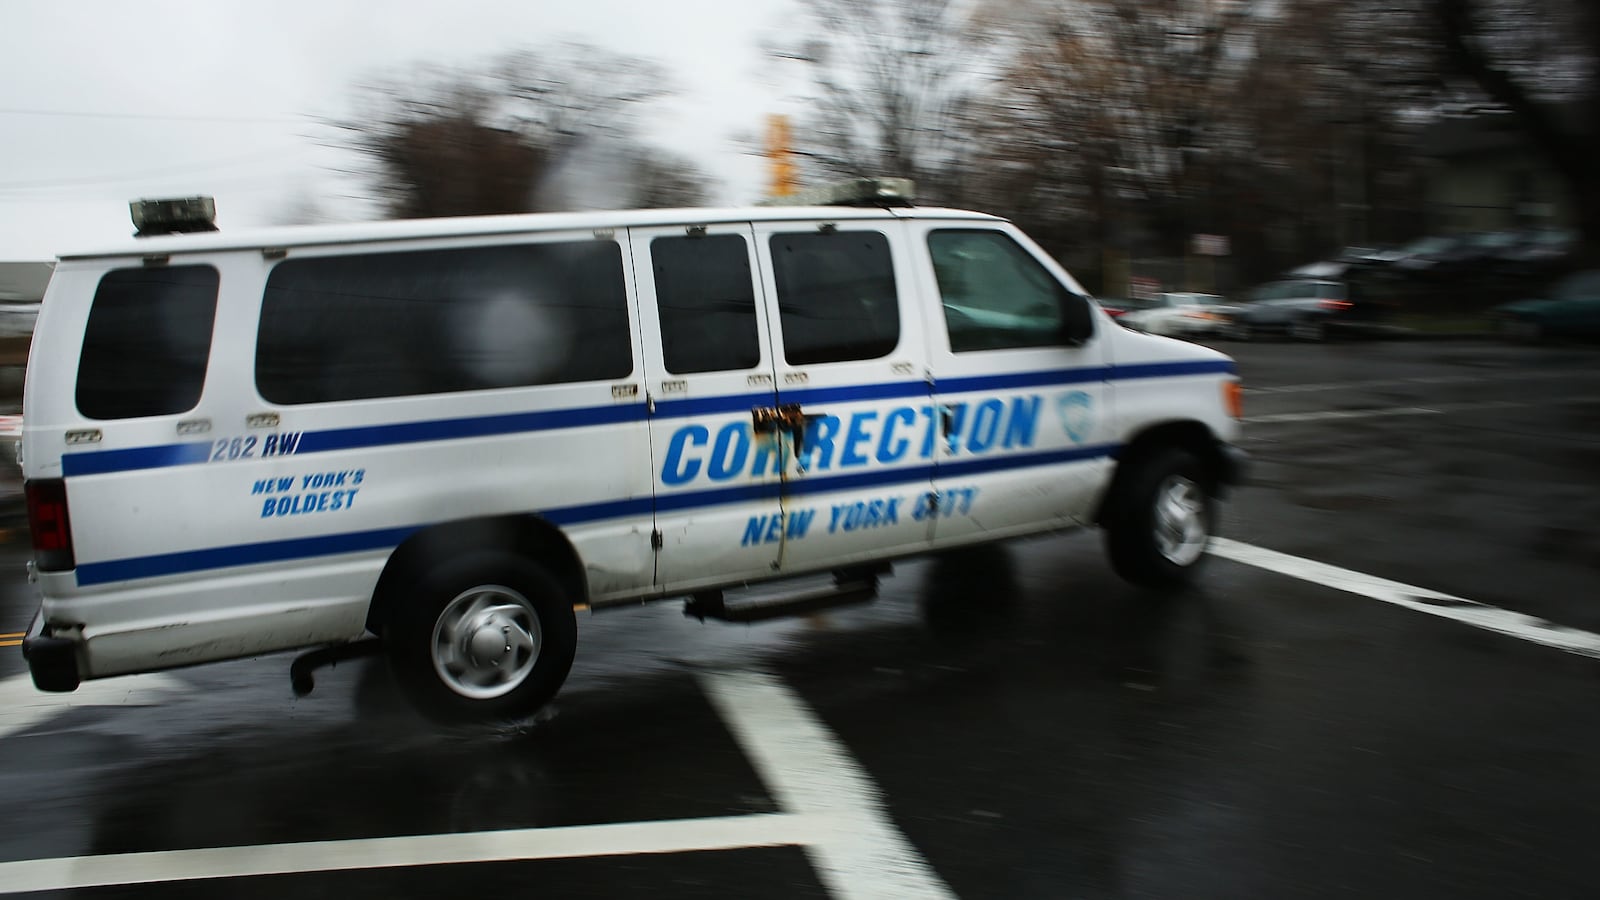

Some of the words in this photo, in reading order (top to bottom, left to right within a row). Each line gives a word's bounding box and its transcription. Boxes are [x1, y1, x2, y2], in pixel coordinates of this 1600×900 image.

[261, 432, 300, 458] RW
[659, 394, 1043, 486] CORRECTION
[251, 475, 295, 495] NEW
[301, 469, 365, 490] YORK'S
[261, 489, 359, 518] BOLDEST
[741, 509, 816, 547] NEW
[828, 496, 904, 534] YORK
